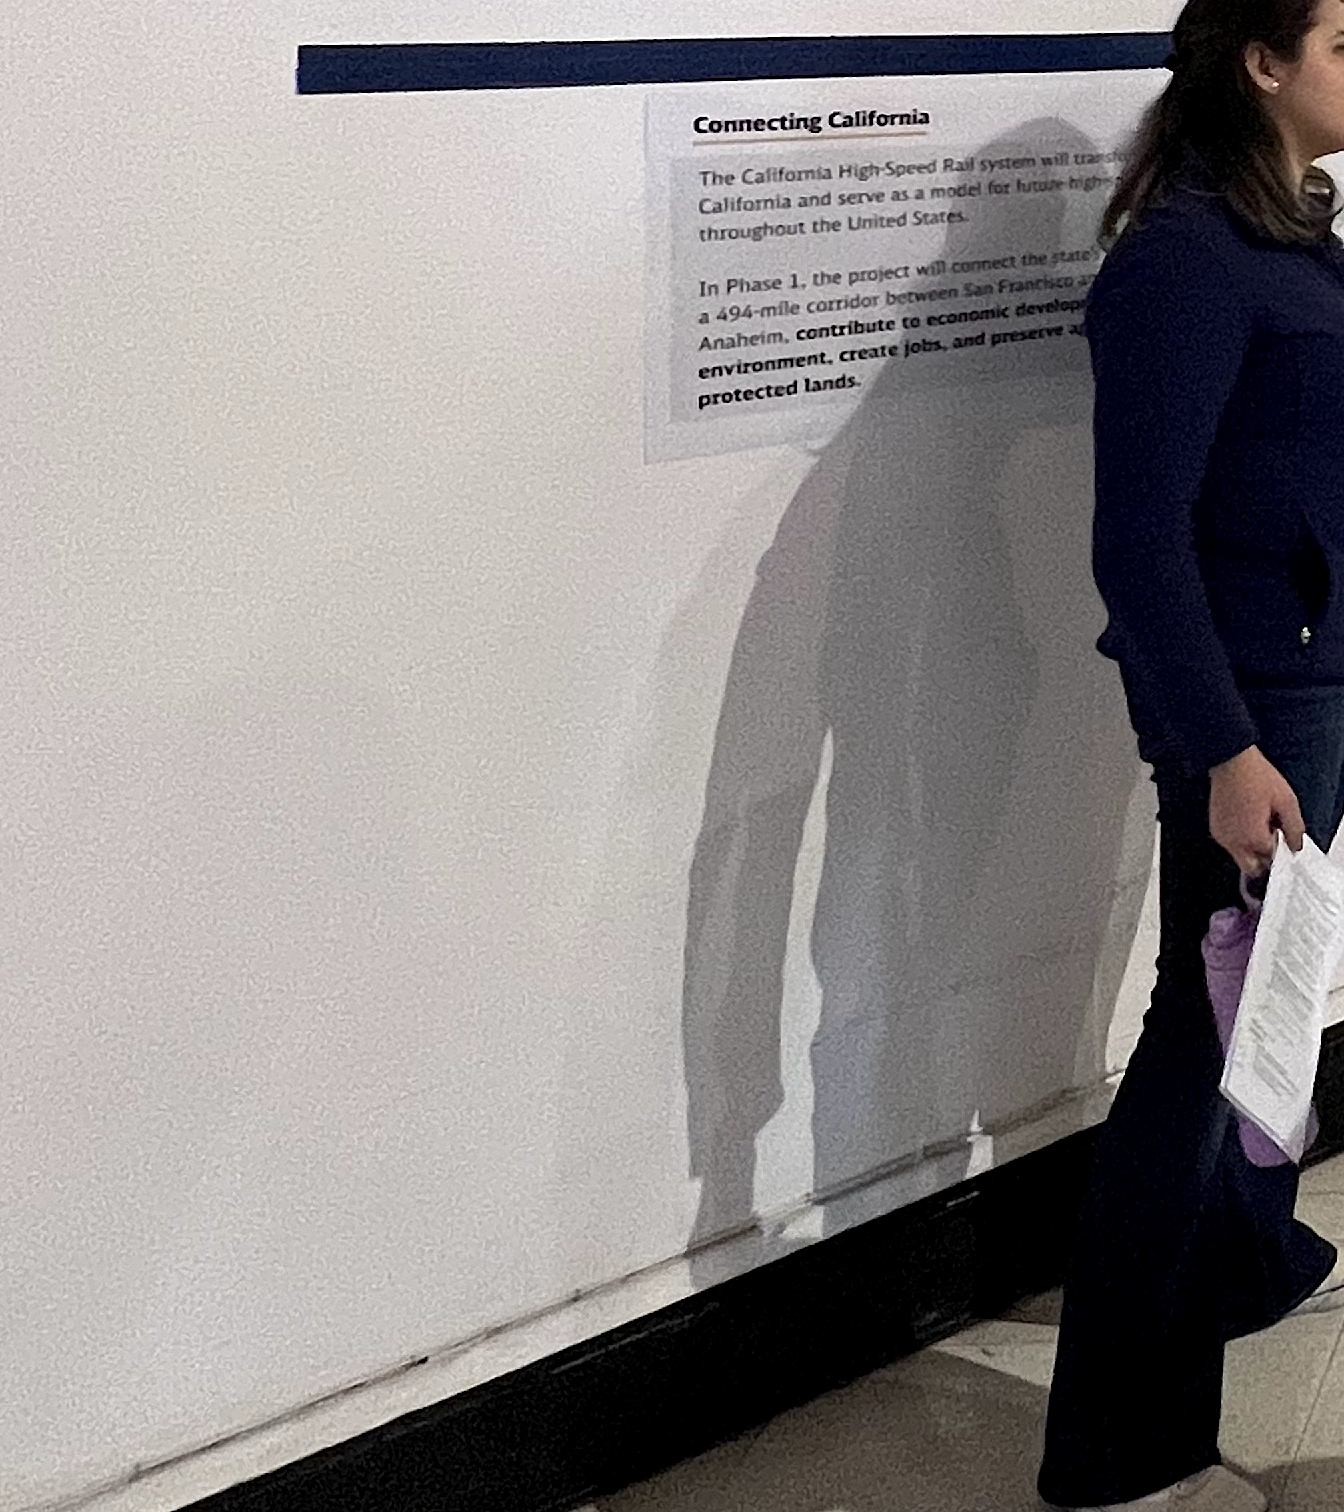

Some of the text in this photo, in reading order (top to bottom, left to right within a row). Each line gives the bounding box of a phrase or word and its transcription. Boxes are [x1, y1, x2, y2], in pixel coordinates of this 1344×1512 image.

[693, 109, 931, 134] Connecting California
[700, 170, 736, 187] The
[741, 166, 832, 185] California
[838, 161, 937, 181] High-Speed
[943, 156, 975, 174] Rail
[981, 156, 1035, 173] system
[1041, 152, 1069, 166] will
[699, 195, 791, 215] California
[798, 192, 831, 209] and
[838, 191, 885, 206] serve
[891, 189, 910, 202] as
[915, 188, 925, 200] a
[930, 181, 982, 199] model
[988, 179, 1010, 195] for
[1016, 179, 1063, 194] future
[699, 210, 970, 243] throughout the United States.
[699, 280, 719, 297] In
[726, 275, 783, 295] Phase
[790, 274, 808, 292] 1,
[812, 270, 842, 287] the
[848, 266, 910, 287] project
[916, 260, 946, 276] will
[952, 256, 1016, 274] connect
[1021, 253, 1047, 267] the
[699, 311, 709, 324] a
[716, 300, 800, 322] 494-mile
[806, 294, 880, 315] corridor
[885, 285, 959, 307] between
[963, 281, 993, 297] San
[999, 274, 1074, 294] Francisco
[699, 332, 790, 351] Anaheim,
[796, 319, 896, 341] contribute
[902, 315, 921, 330] to
[926, 306, 1010, 327] economic
[699, 351, 833, 381] environment,
[839, 343, 898, 363] create
[904, 336, 947, 359] jobs,
[953, 331, 986, 348] and
[991, 324, 1064, 346] preserve
[698, 374, 862, 410] protected lands.
